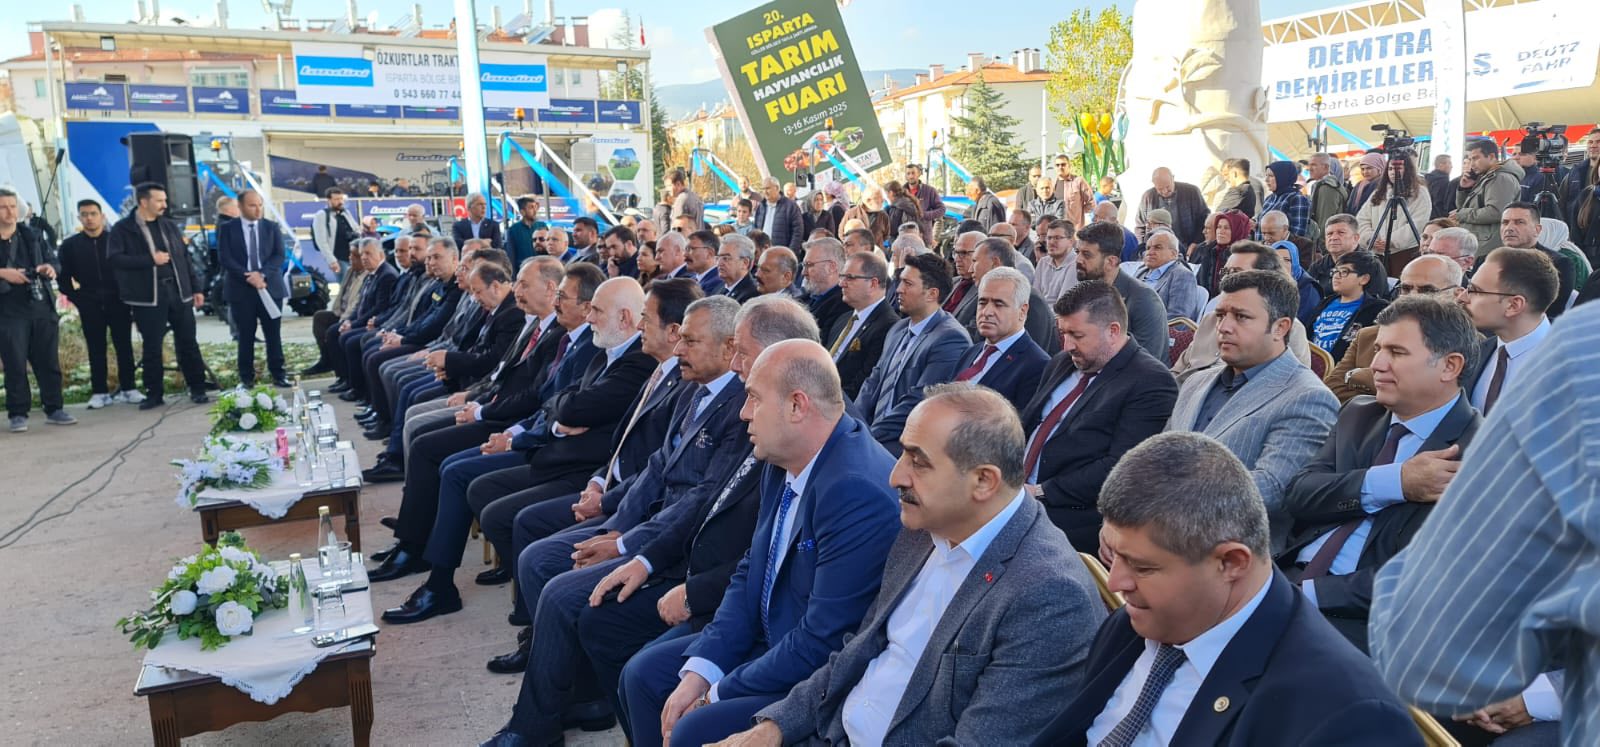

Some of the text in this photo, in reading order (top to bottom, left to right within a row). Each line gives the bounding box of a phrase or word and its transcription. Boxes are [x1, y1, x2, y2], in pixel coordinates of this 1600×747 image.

[764, 9, 785, 26] 20.
[746, 12, 815, 50] ISPARTA
[377, 48, 430, 67] ÖZKURTLAR
[740, 29, 840, 87] TARIM
[1517, 41, 1580, 62] DEUTZ
[1521, 57, 1572, 75] FAHR
[753, 54, 845, 101] HAYVANCILIK
[394, 88, 400, 99] 0
[402, 89, 418, 99] 543
[420, 89, 437, 100] 660
[439, 90, 449, 99] 77
[764, 72, 848, 123] FUARI
[1305, 97, 1359, 113] Isparta
[783, 119, 803, 136] 13-16
[828, 101, 848, 116] 2025
